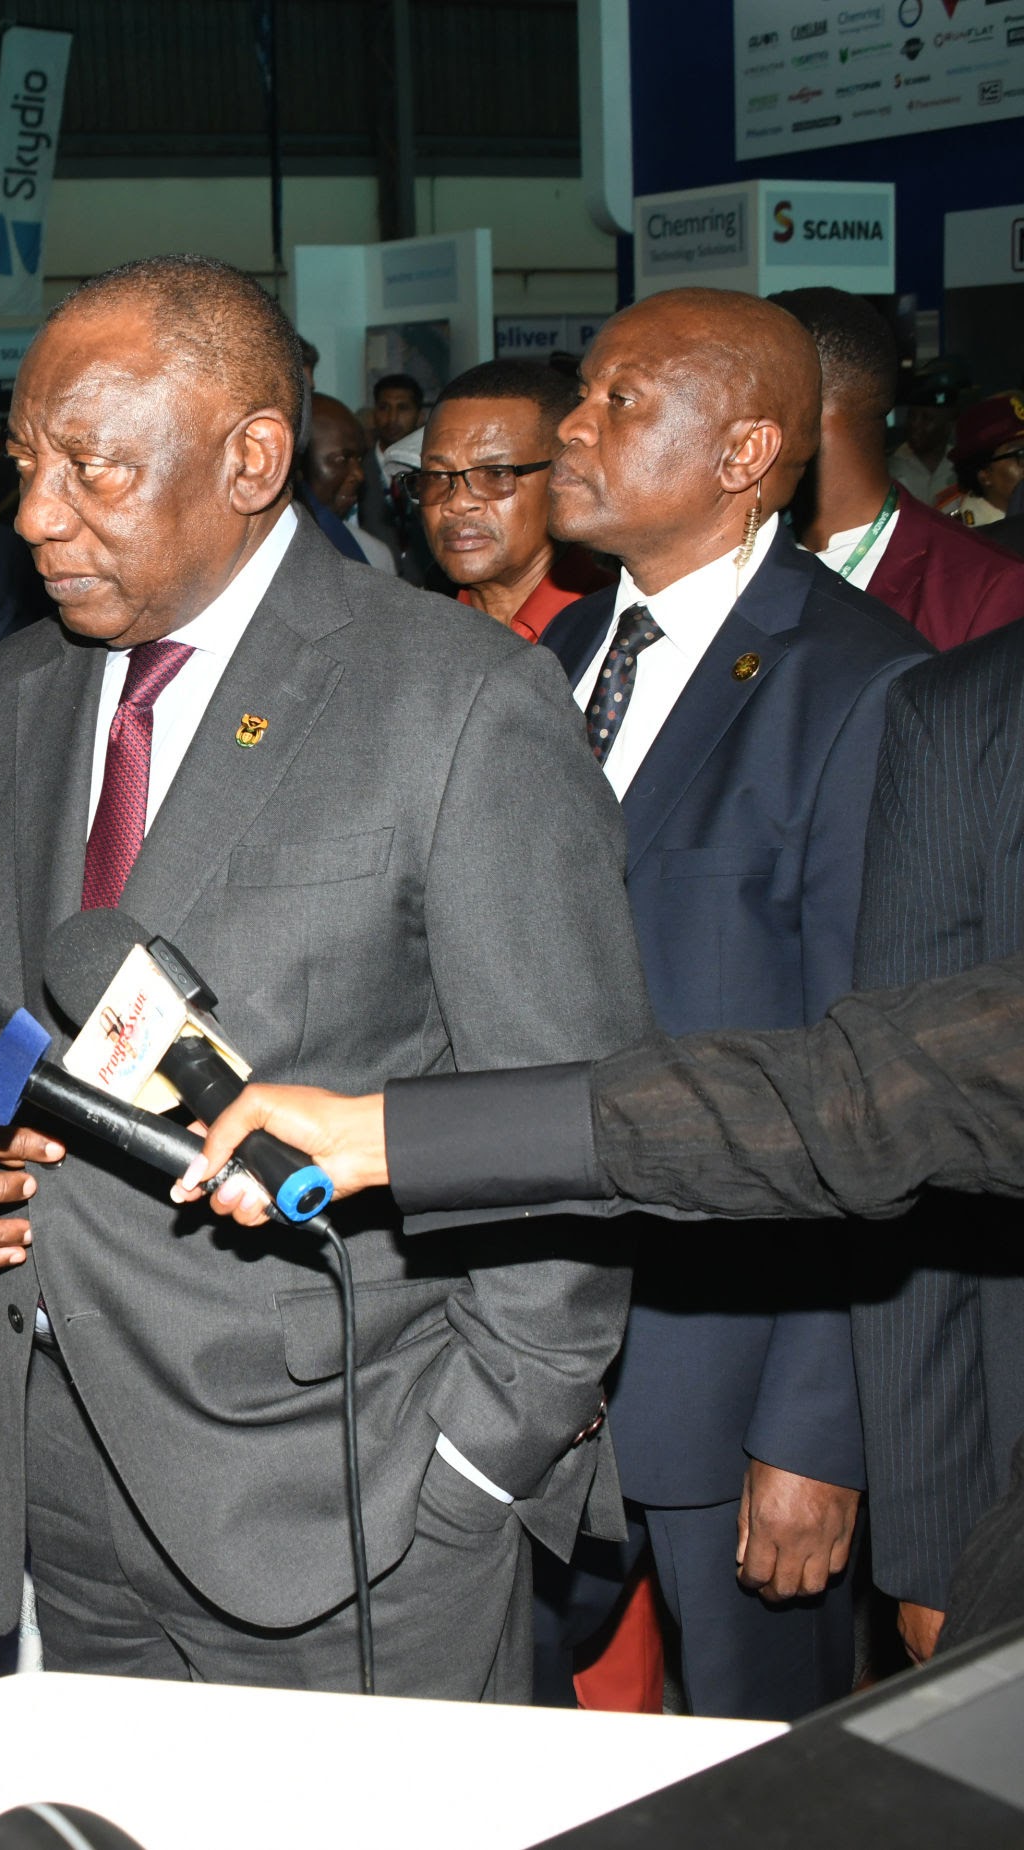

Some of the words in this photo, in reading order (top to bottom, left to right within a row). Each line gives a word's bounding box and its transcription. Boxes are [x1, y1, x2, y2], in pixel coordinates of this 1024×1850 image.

[3, 69, 52, 201] Skydio
[647, 207, 736, 241] Chemring
[802, 217, 884, 242] SCANNA
[649, 246, 695, 263] Technology
[698, 241, 737, 259] Solutions
[496, 326, 559, 347] eliver
